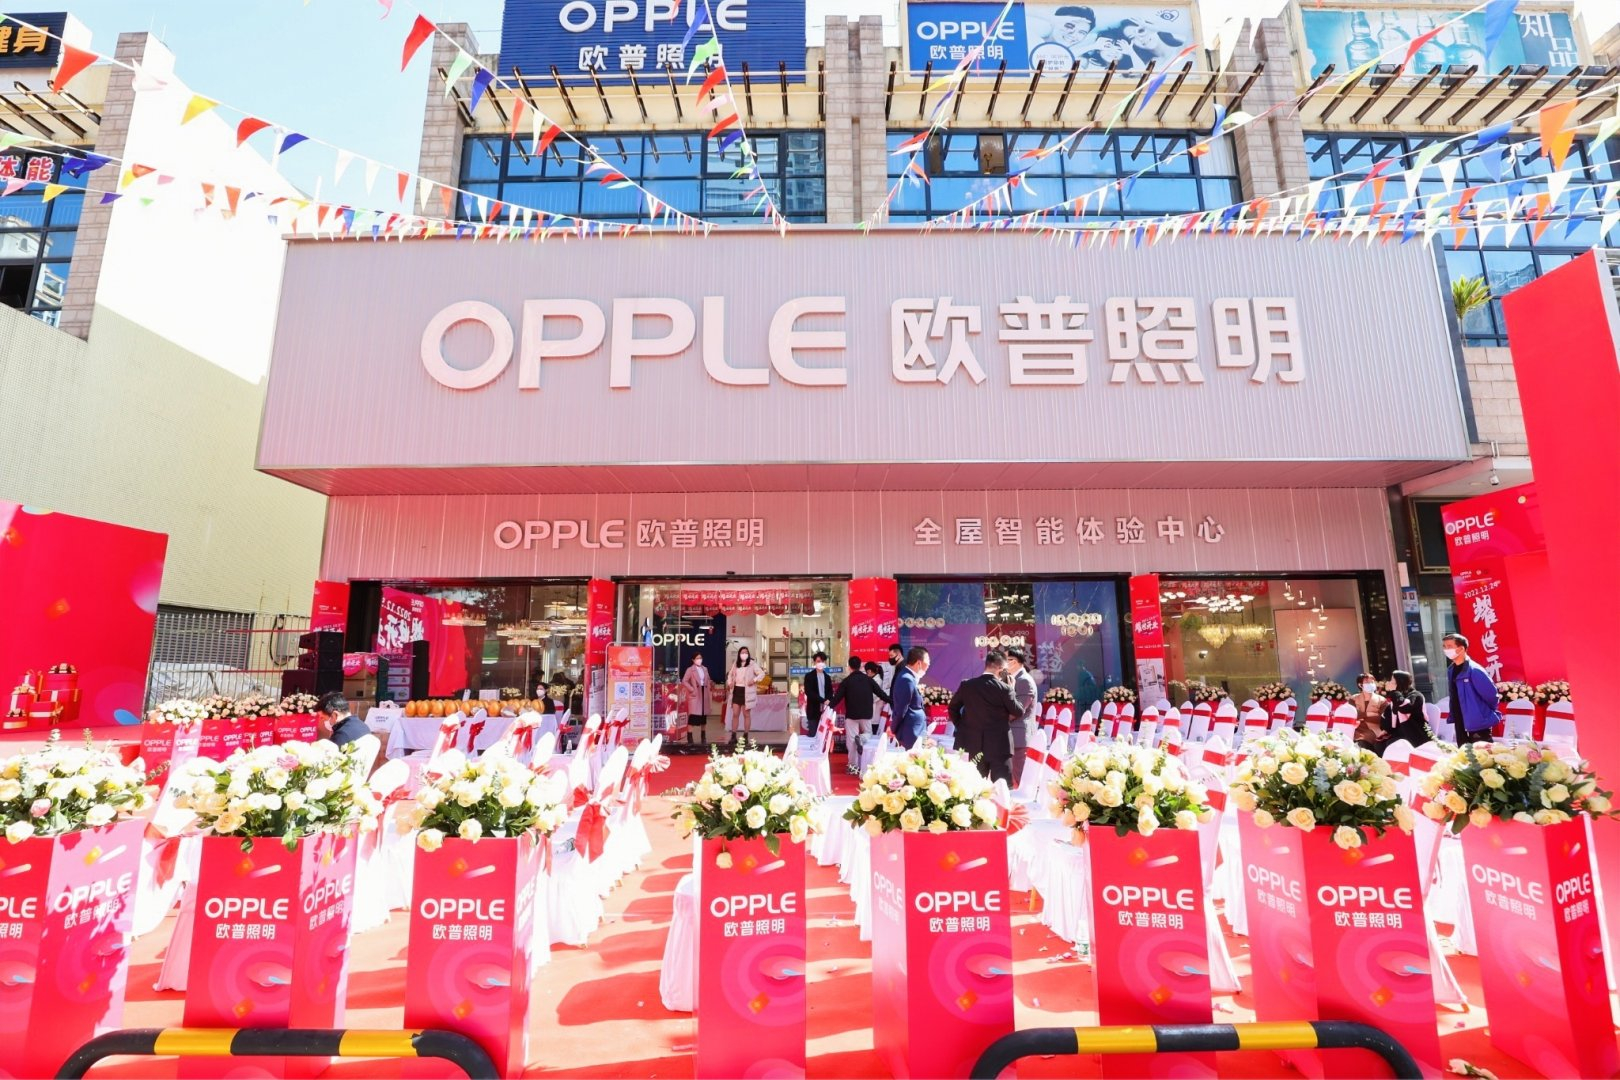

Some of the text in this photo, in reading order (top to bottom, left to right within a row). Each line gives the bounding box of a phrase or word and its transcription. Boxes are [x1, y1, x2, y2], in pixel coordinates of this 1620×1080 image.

[559, 0, 748, 32] OPPLE
[917, 21, 1015, 40] OPPLE
[421, 295, 1307, 390] OPPLE 欧普照明
[493, 519, 765, 550] OPPLE 欧普照明
[914, 515, 1226, 546] 全屋智能体验中心
[1445, 512, 1494, 535] OPPLE
[1454, 530, 1490, 547] 欧普照明
[652, 633, 705, 646] OPPLE
[54, 872, 133, 913] OPPLE
[303, 873, 351, 914] OPPLE
[1248, 864, 1302, 902] OPPLE
[1471, 864, 1545, 905] OPPLE
[1555, 873, 1592, 905] OPPLE
[204, 897, 289, 920] OPPLE
[710, 892, 797, 918] OPPLE
[915, 890, 1001, 913] OPPLE
[1102, 885, 1195, 910] OPPLE
[1317, 885, 1413, 909] OPPLE
[420, 898, 505, 920] OPPLE
[1118, 910, 1184, 930] 欧普照明
[1334, 911, 1404, 929] 欧普照明
[215, 923, 277, 941] 欧普照明
[432, 923, 494, 941] 欧普照明
[724, 918, 786, 937] 欧普照明
[929, 916, 992, 933] 欧普照明
